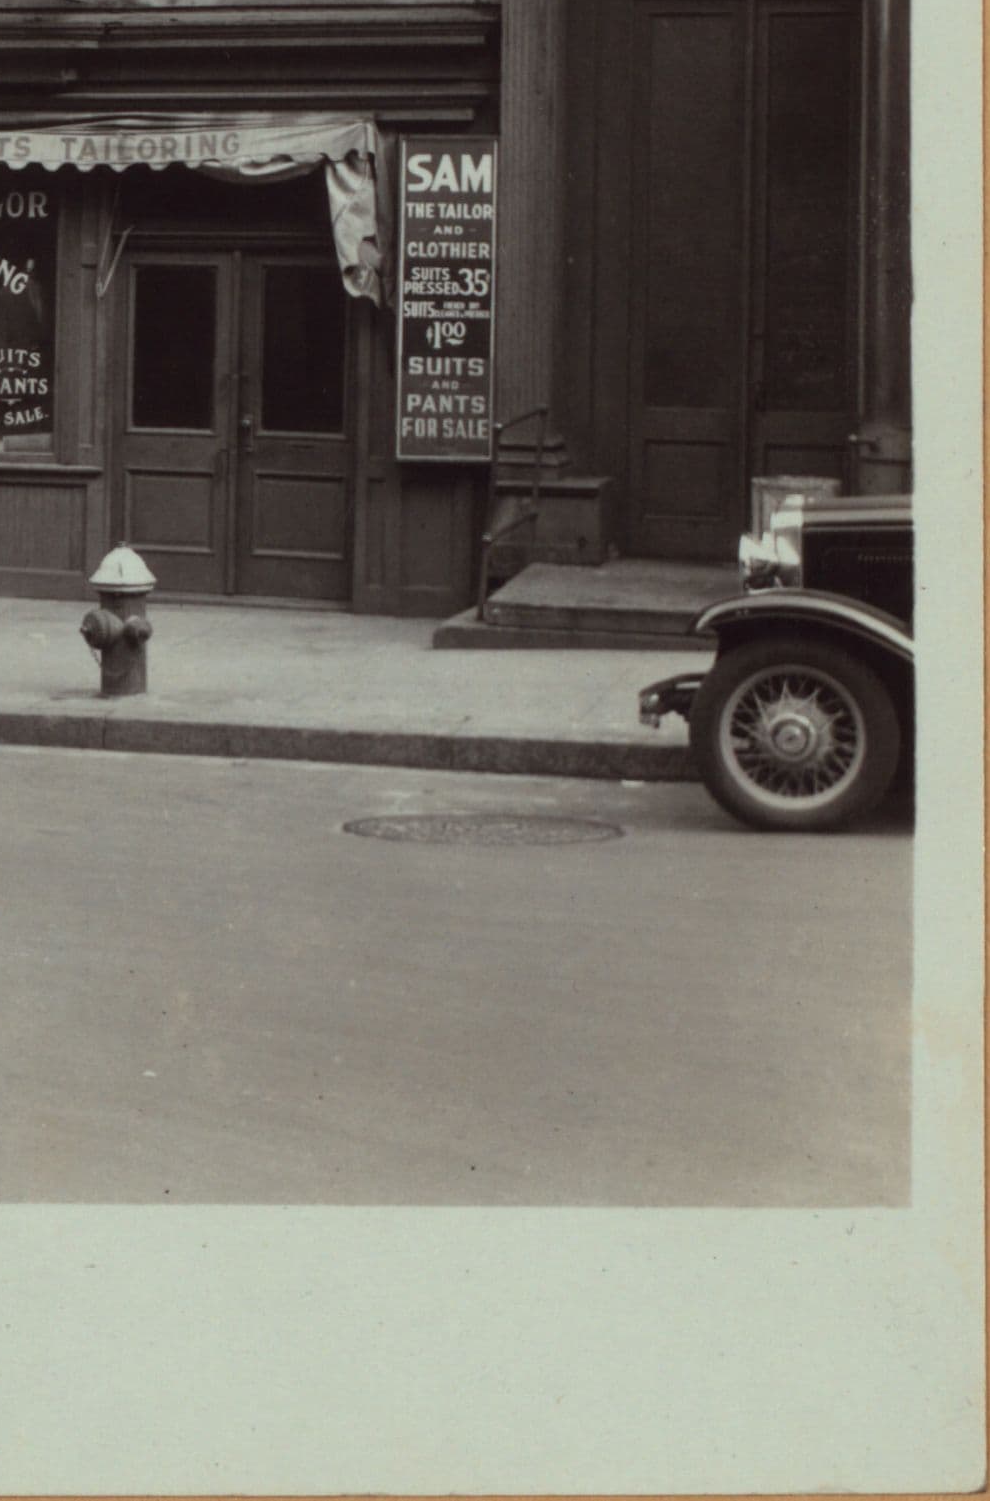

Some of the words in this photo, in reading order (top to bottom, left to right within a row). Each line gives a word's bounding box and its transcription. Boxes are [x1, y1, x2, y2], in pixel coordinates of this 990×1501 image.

[61, 132, 240, 161] TAILORING
[408, 153, 492, 193] SAM
[407, 202, 435, 219] THE
[438, 203, 493, 219] TAILOR
[434, 225, 463, 235] AND
[408, 241, 490, 258] CLOTHIER
[412, 267, 451, 280] SUITS
[404, 281, 459, 295] PRESSED
[403, 301, 435, 318] SUITS
[408, 356, 484, 376] SUITS
[432, 380, 459, 390] AND
[407, 394, 485, 414] PANTS
[402, 417, 437, 438] FOR
[443, 417, 489, 439] SALE
